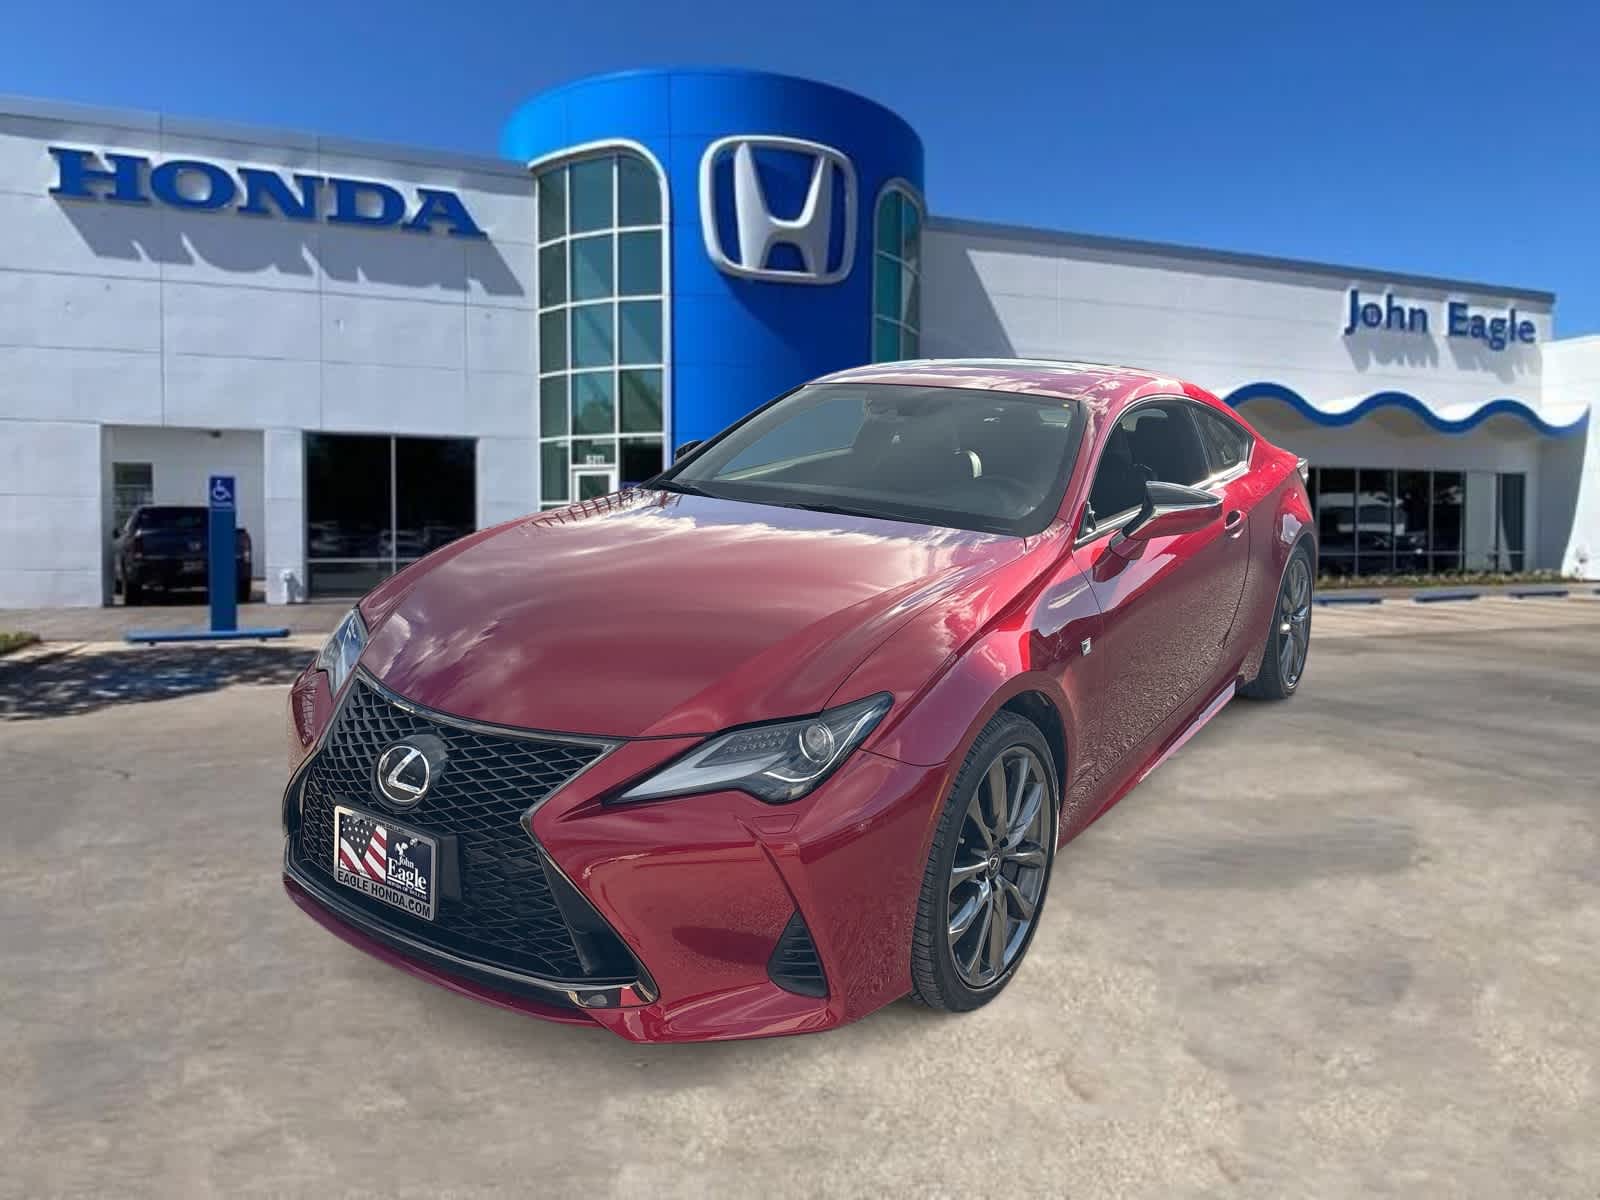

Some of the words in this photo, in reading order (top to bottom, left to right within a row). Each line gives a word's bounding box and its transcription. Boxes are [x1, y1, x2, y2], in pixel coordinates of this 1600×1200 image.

[49, 146, 487, 239] HONDA
[1344, 289, 1428, 335] John
[1447, 302, 1536, 351] Eagle
[387, 856, 427, 890] Eagle
[398, 856, 415, 868] John
[337, 870, 369, 893] EAGLE
[371, 884, 431, 918] HONDA.COM
